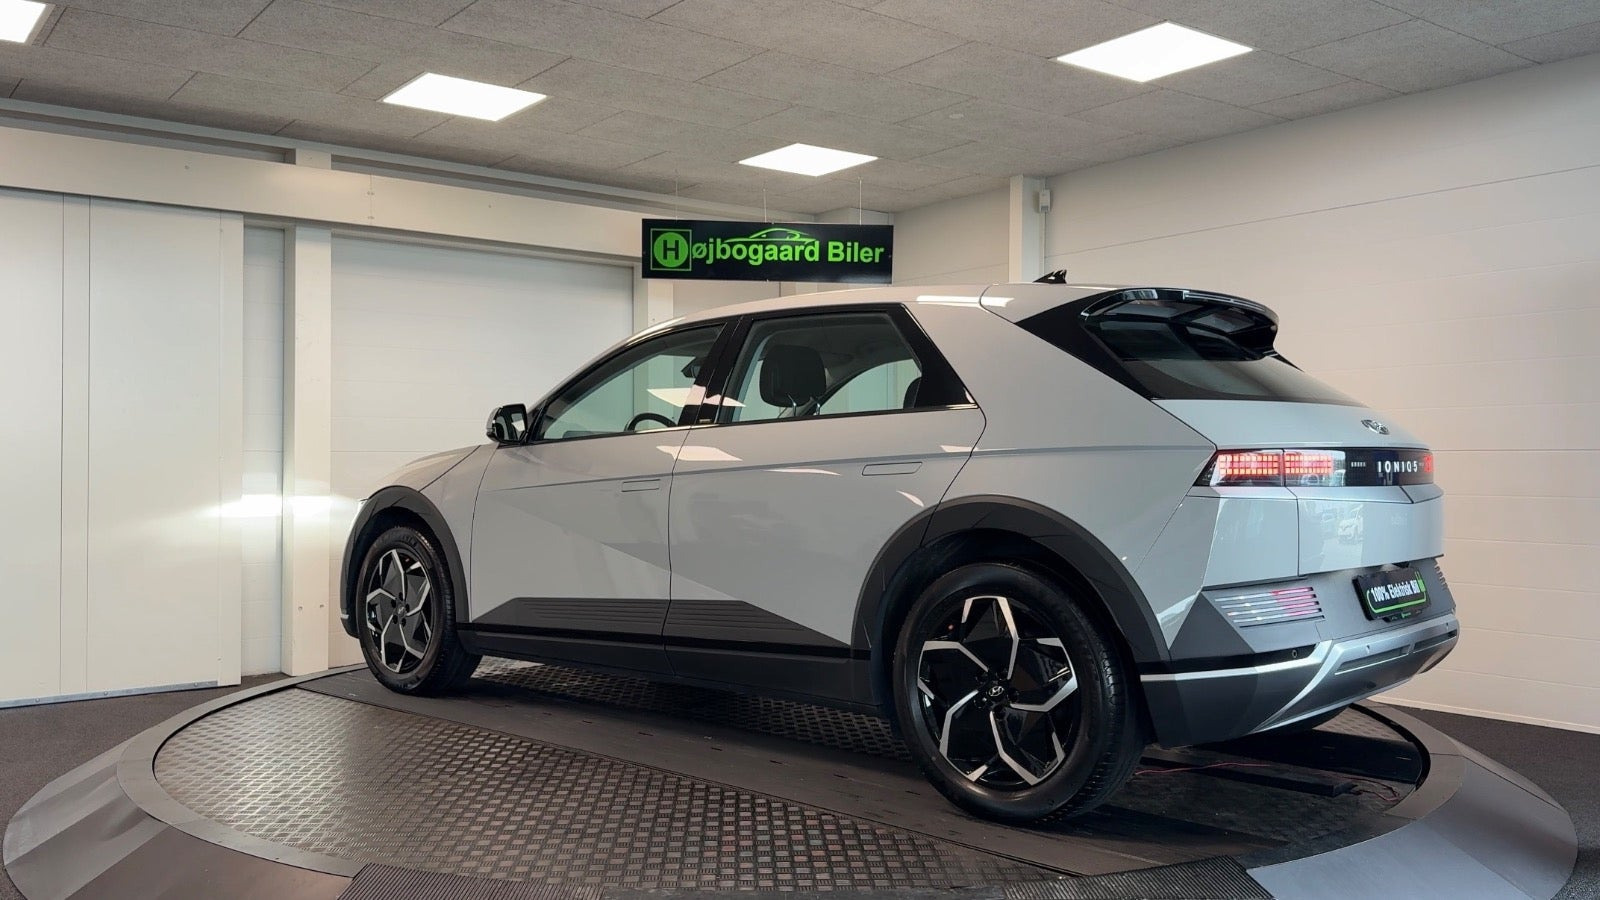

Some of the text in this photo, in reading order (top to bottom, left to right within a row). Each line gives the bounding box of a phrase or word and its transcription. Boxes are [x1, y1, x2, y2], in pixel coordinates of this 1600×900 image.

[828, 240, 884, 263] Biler
[1371, 586, 1391, 602] 100%
[1387, 581, 1414, 599] Elektrisk
